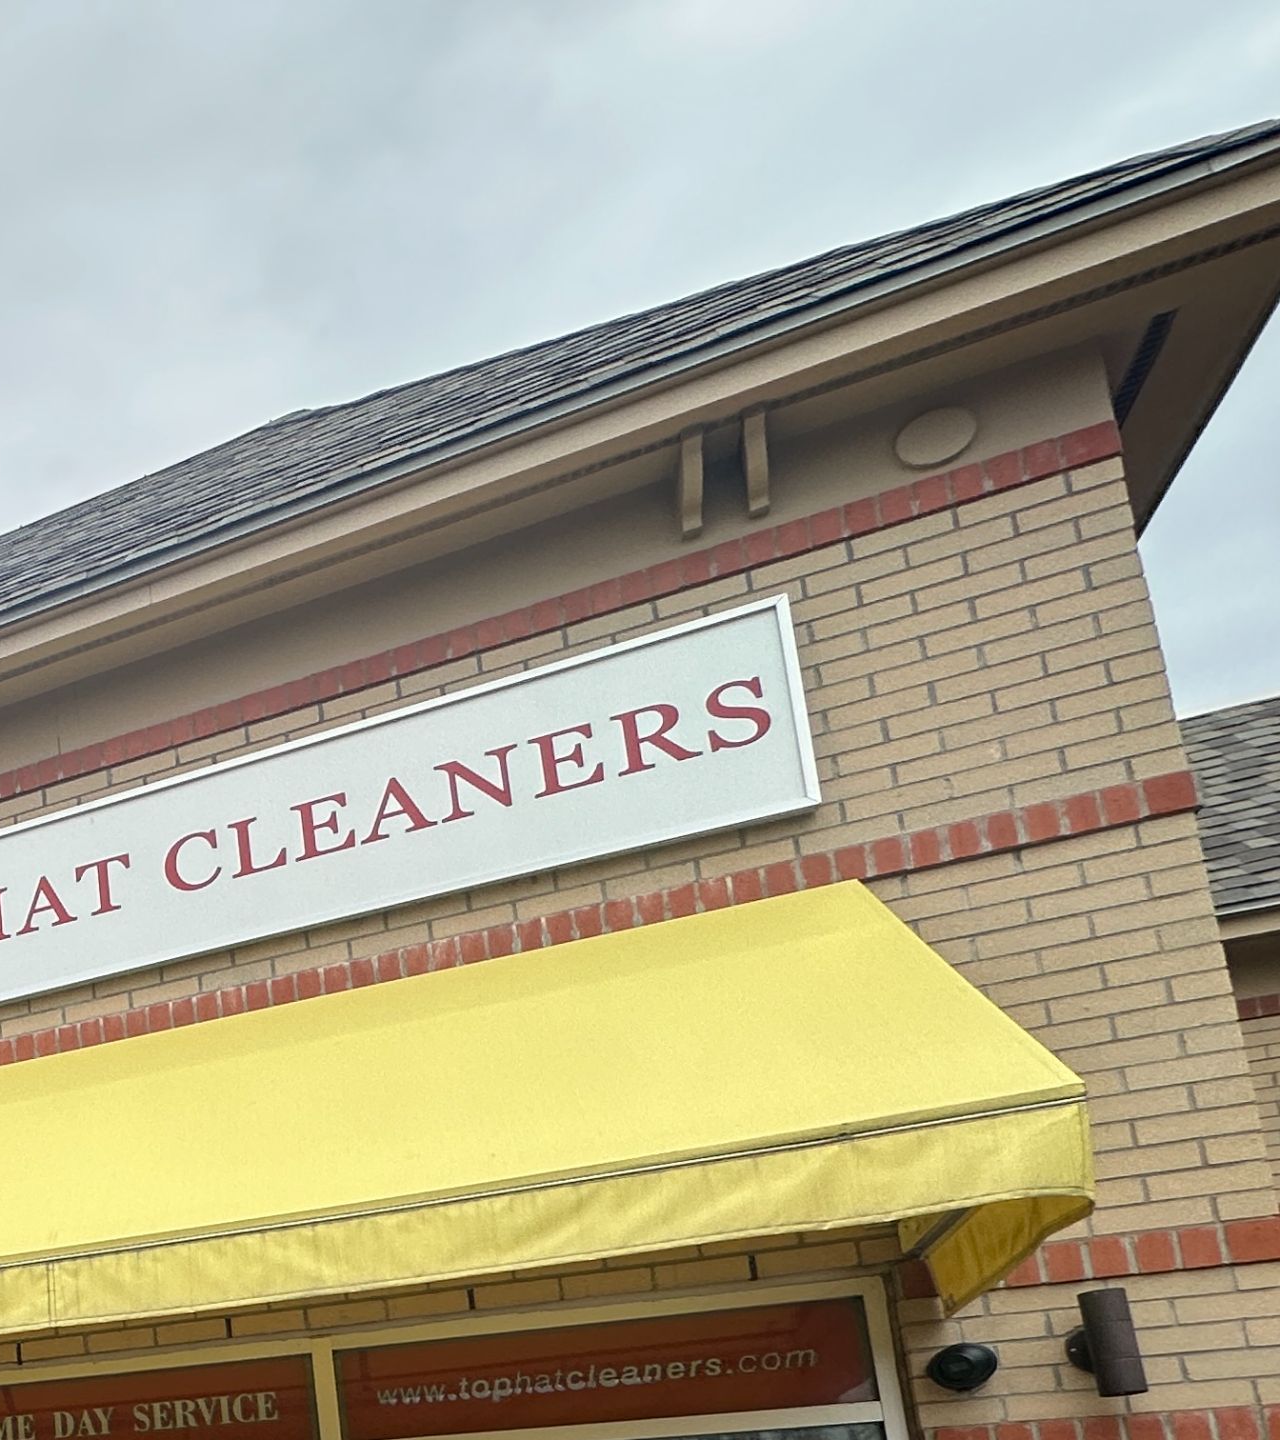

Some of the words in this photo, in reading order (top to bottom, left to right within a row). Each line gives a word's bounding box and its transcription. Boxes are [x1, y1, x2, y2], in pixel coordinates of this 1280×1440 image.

[162, 675, 773, 892] CLEANERS
[376, 1344, 817, 1407] www.tophatcleaners.com
[53, 1406, 115, 1440] DAY
[133, 1391, 279, 1433] SERVICE
